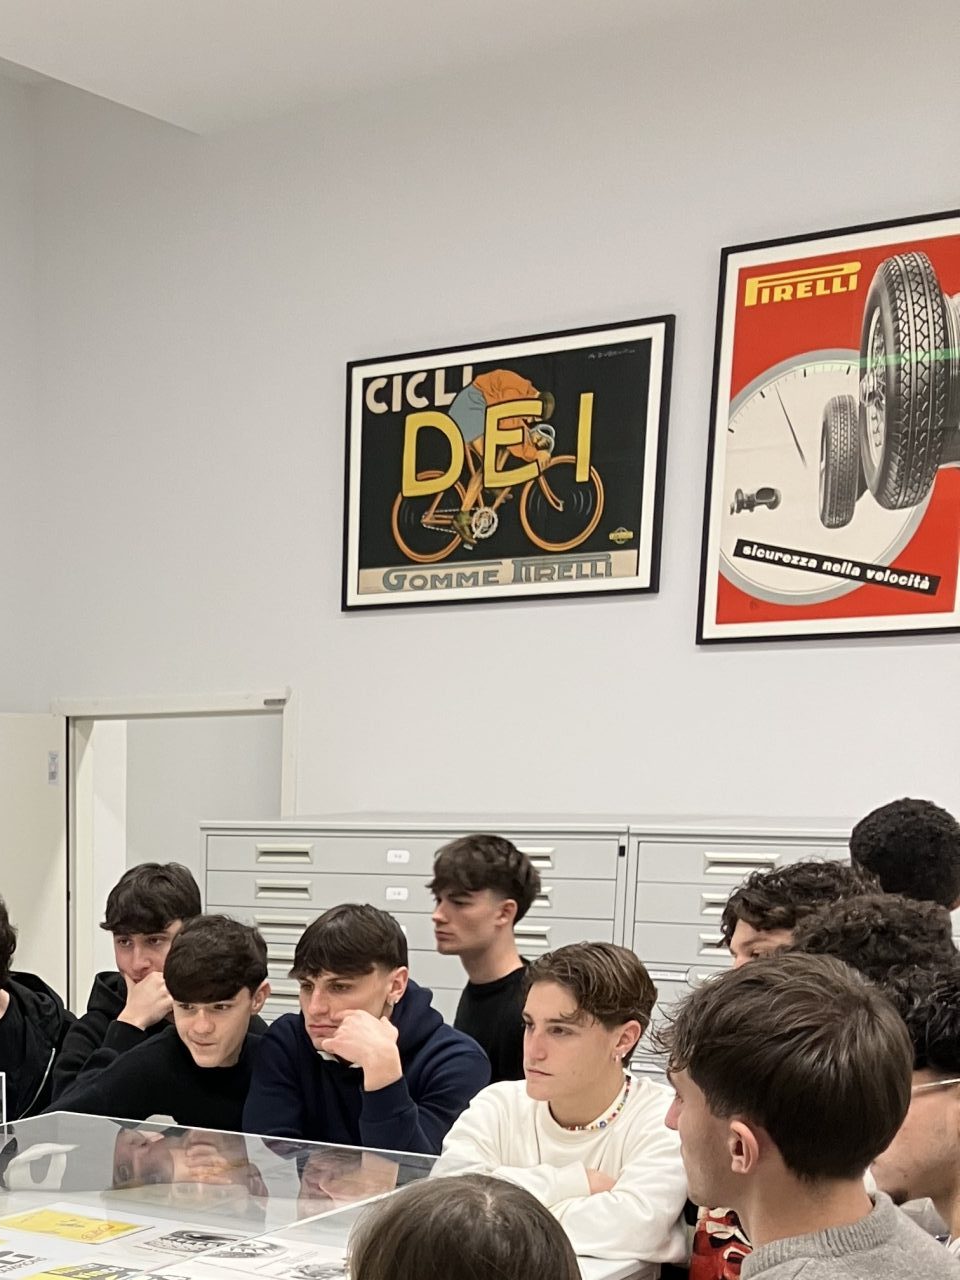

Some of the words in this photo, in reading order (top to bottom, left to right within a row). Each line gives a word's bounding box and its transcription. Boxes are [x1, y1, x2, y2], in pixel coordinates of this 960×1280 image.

[744, 261, 862, 307] PIRELLI
[365, 365, 473, 415] CICLI
[402, 392, 594, 497] DEI
[382, 561, 503, 591] GOMME
[511, 553, 613, 584] PIRELLI
[742, 544, 817, 569] sicurezza
[822, 557, 861, 577] nella
[866, 568, 930, 590] velocità
